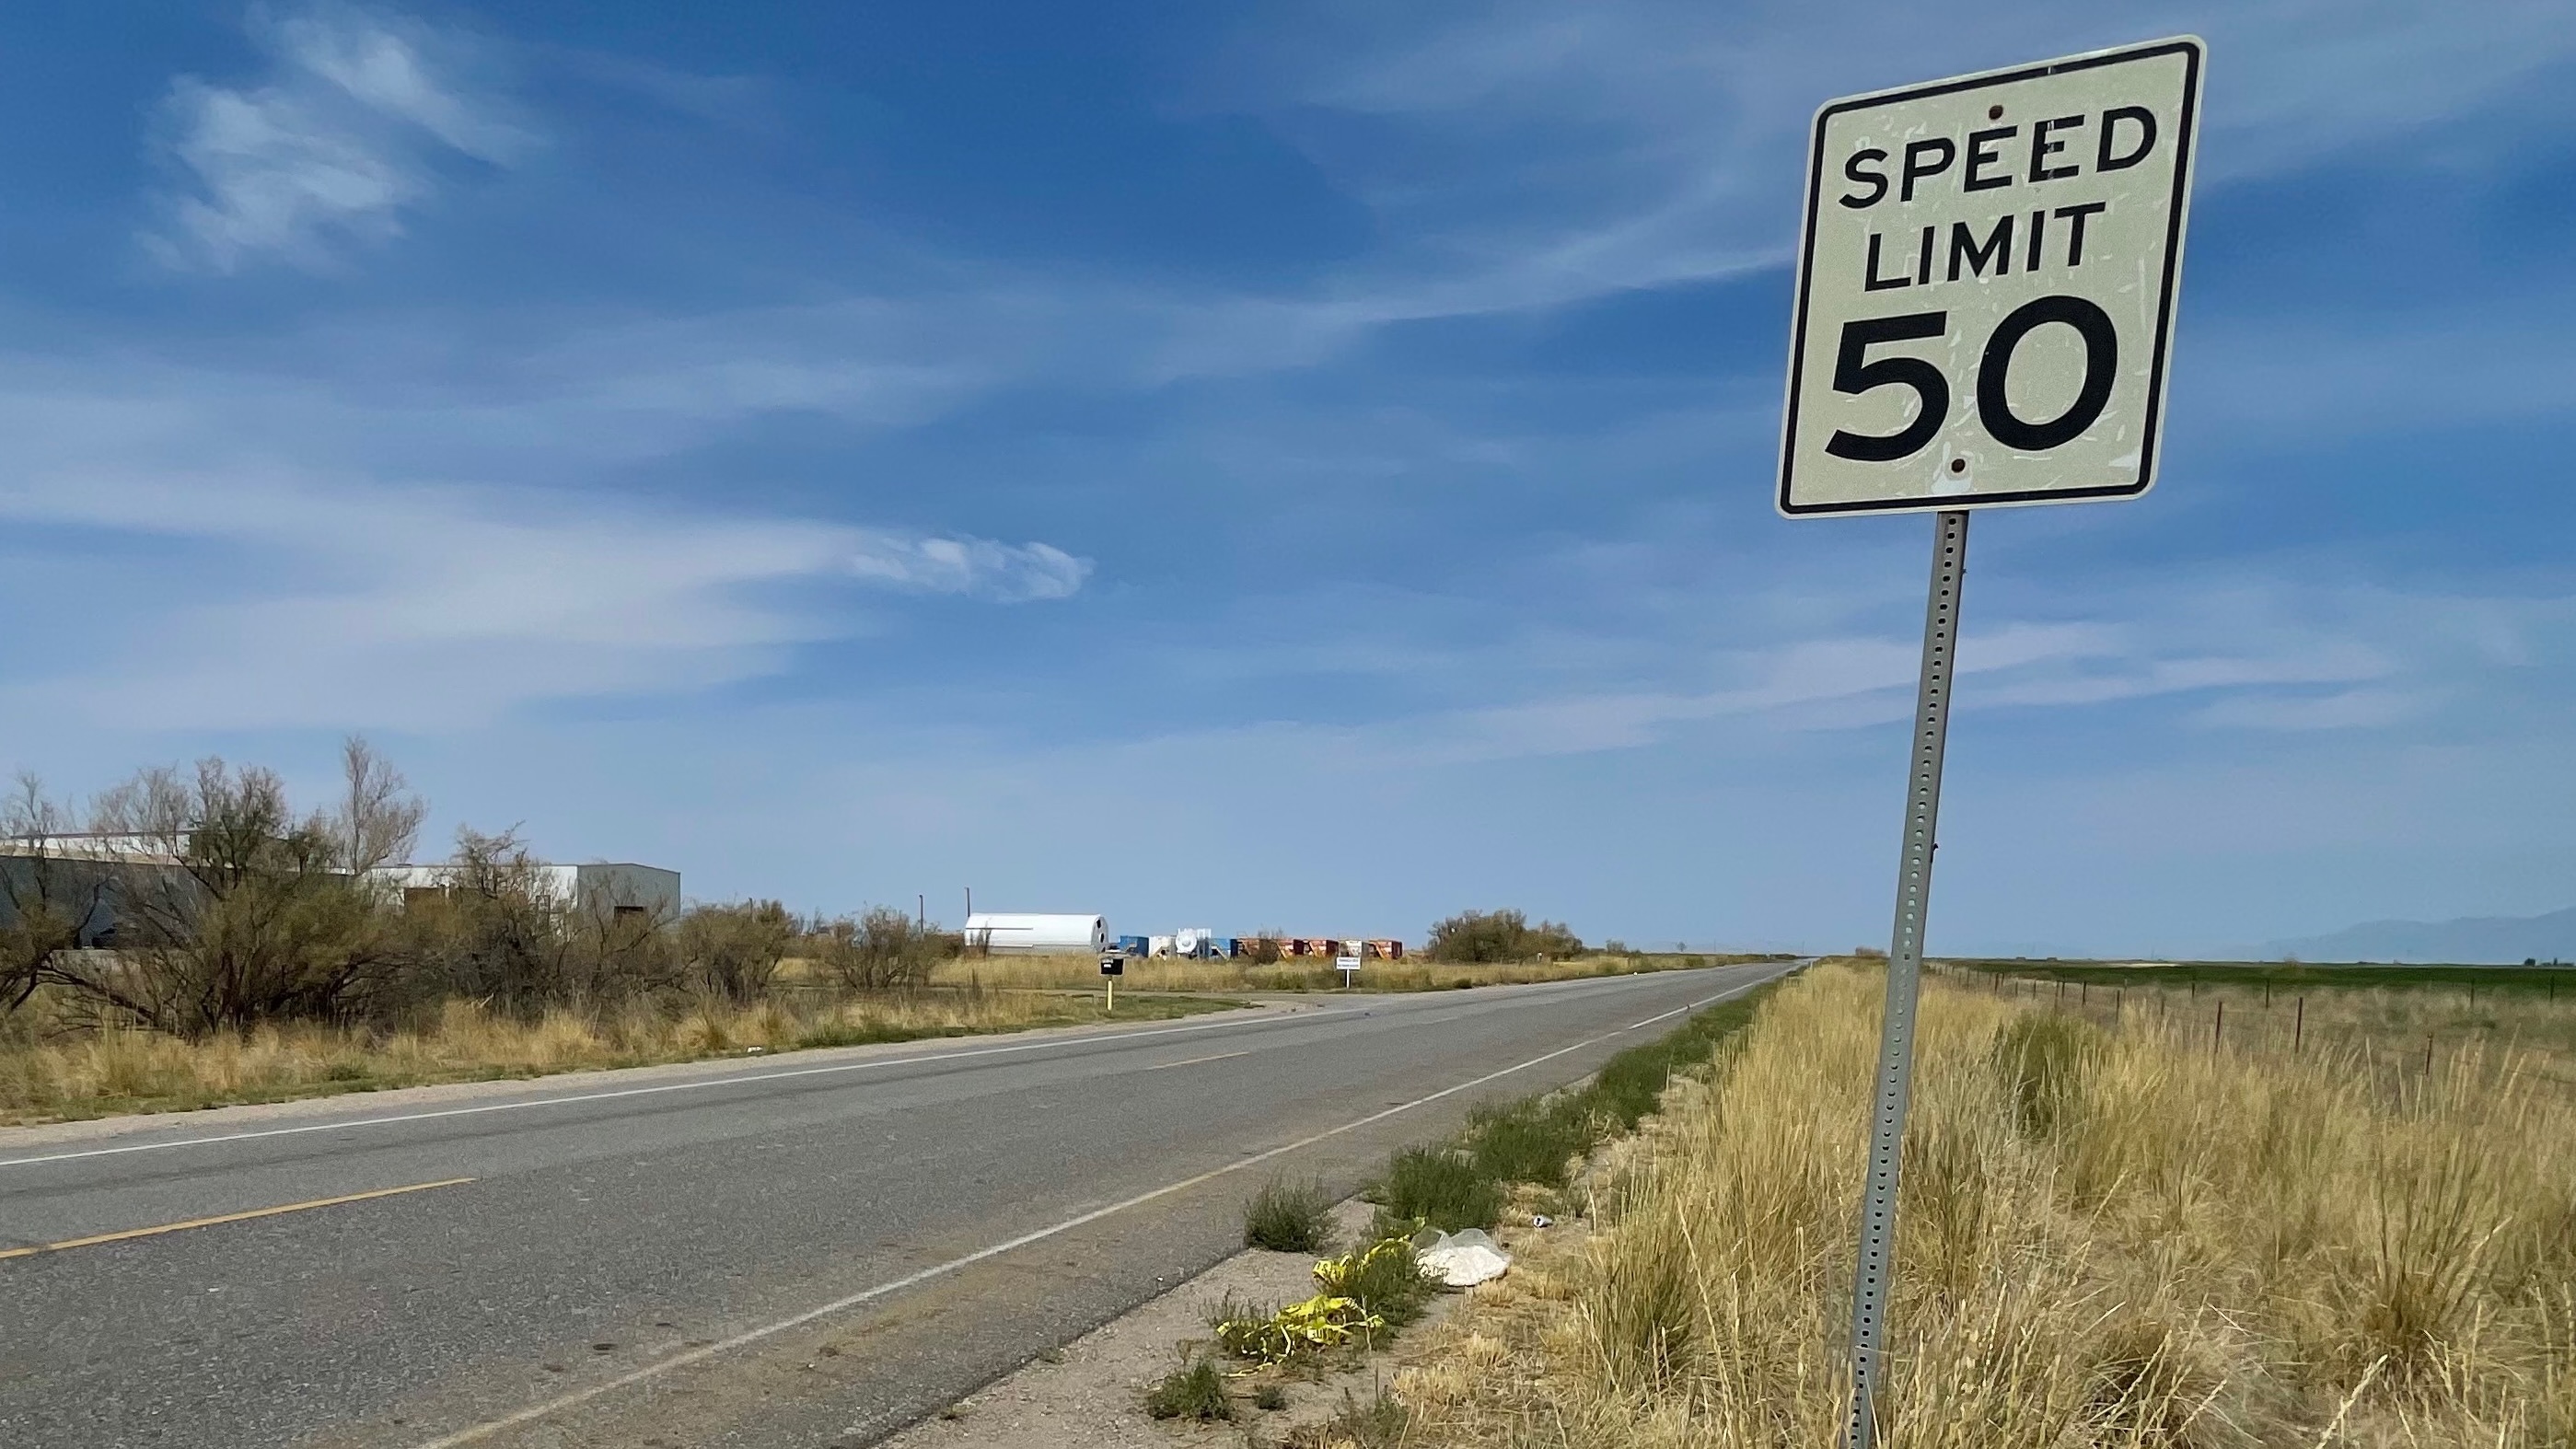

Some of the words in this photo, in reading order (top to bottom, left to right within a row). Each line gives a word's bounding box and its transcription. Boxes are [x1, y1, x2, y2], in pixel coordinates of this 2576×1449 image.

[1839, 106, 2157, 209] SPEED
[1864, 202, 2106, 292] LIMIT
[1825, 295, 2118, 462] 50
